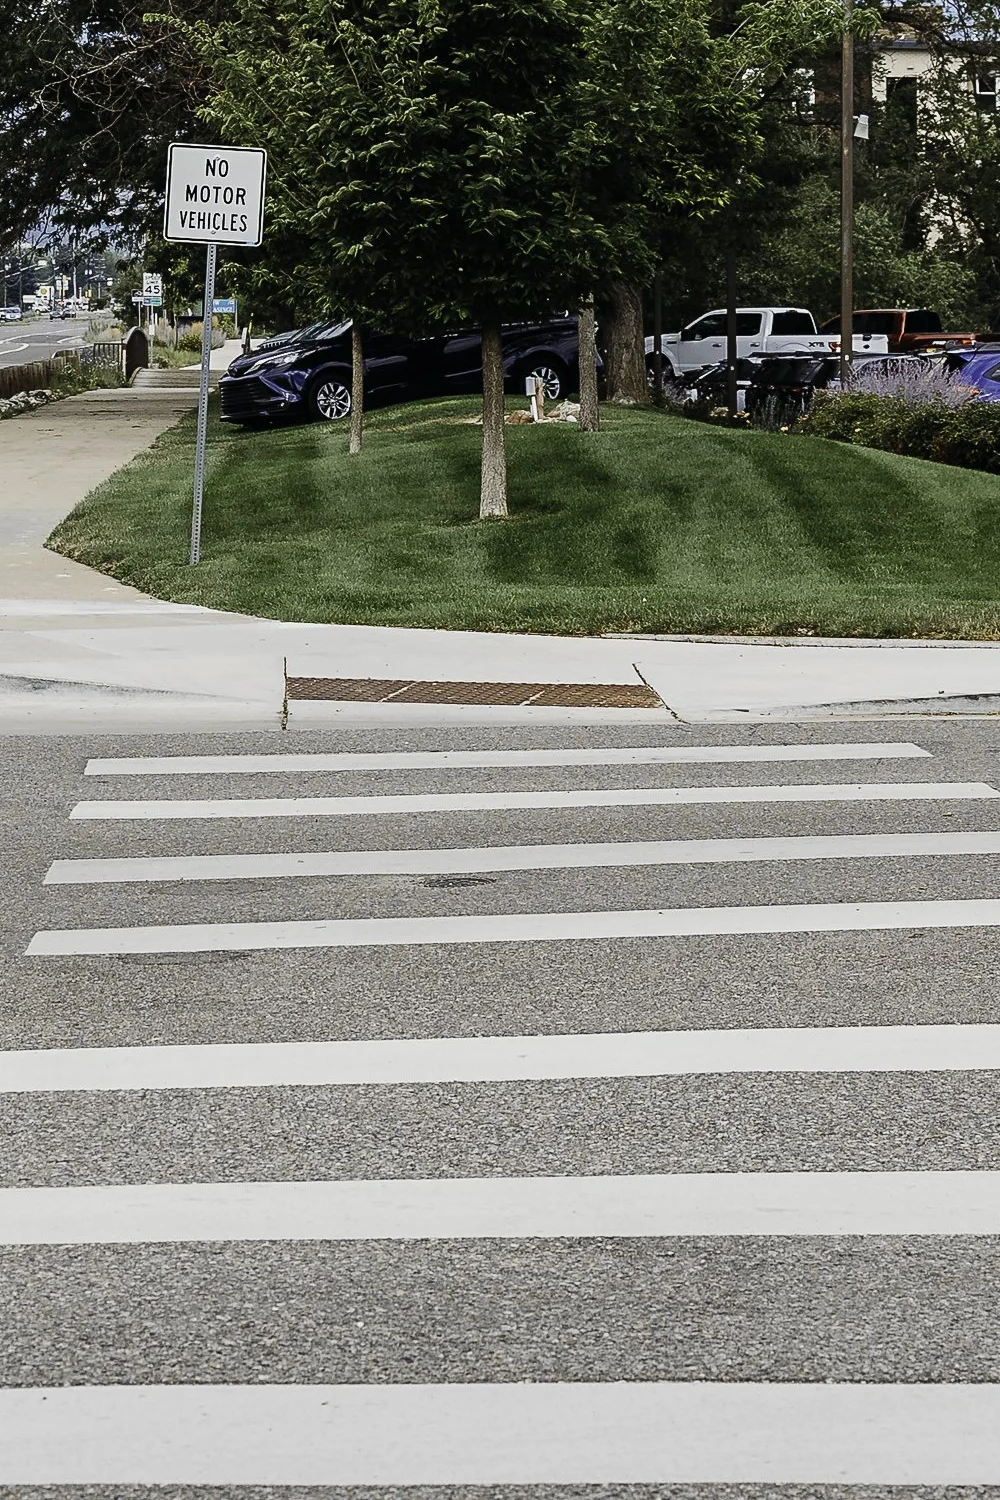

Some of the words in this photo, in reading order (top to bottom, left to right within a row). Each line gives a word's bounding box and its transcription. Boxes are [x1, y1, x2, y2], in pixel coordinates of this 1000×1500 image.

[205, 158, 229, 177] NO
[185, 184, 247, 205] MOTOR
[179, 210, 248, 232] VEHICLES
[144, 285, 161, 295] 45
